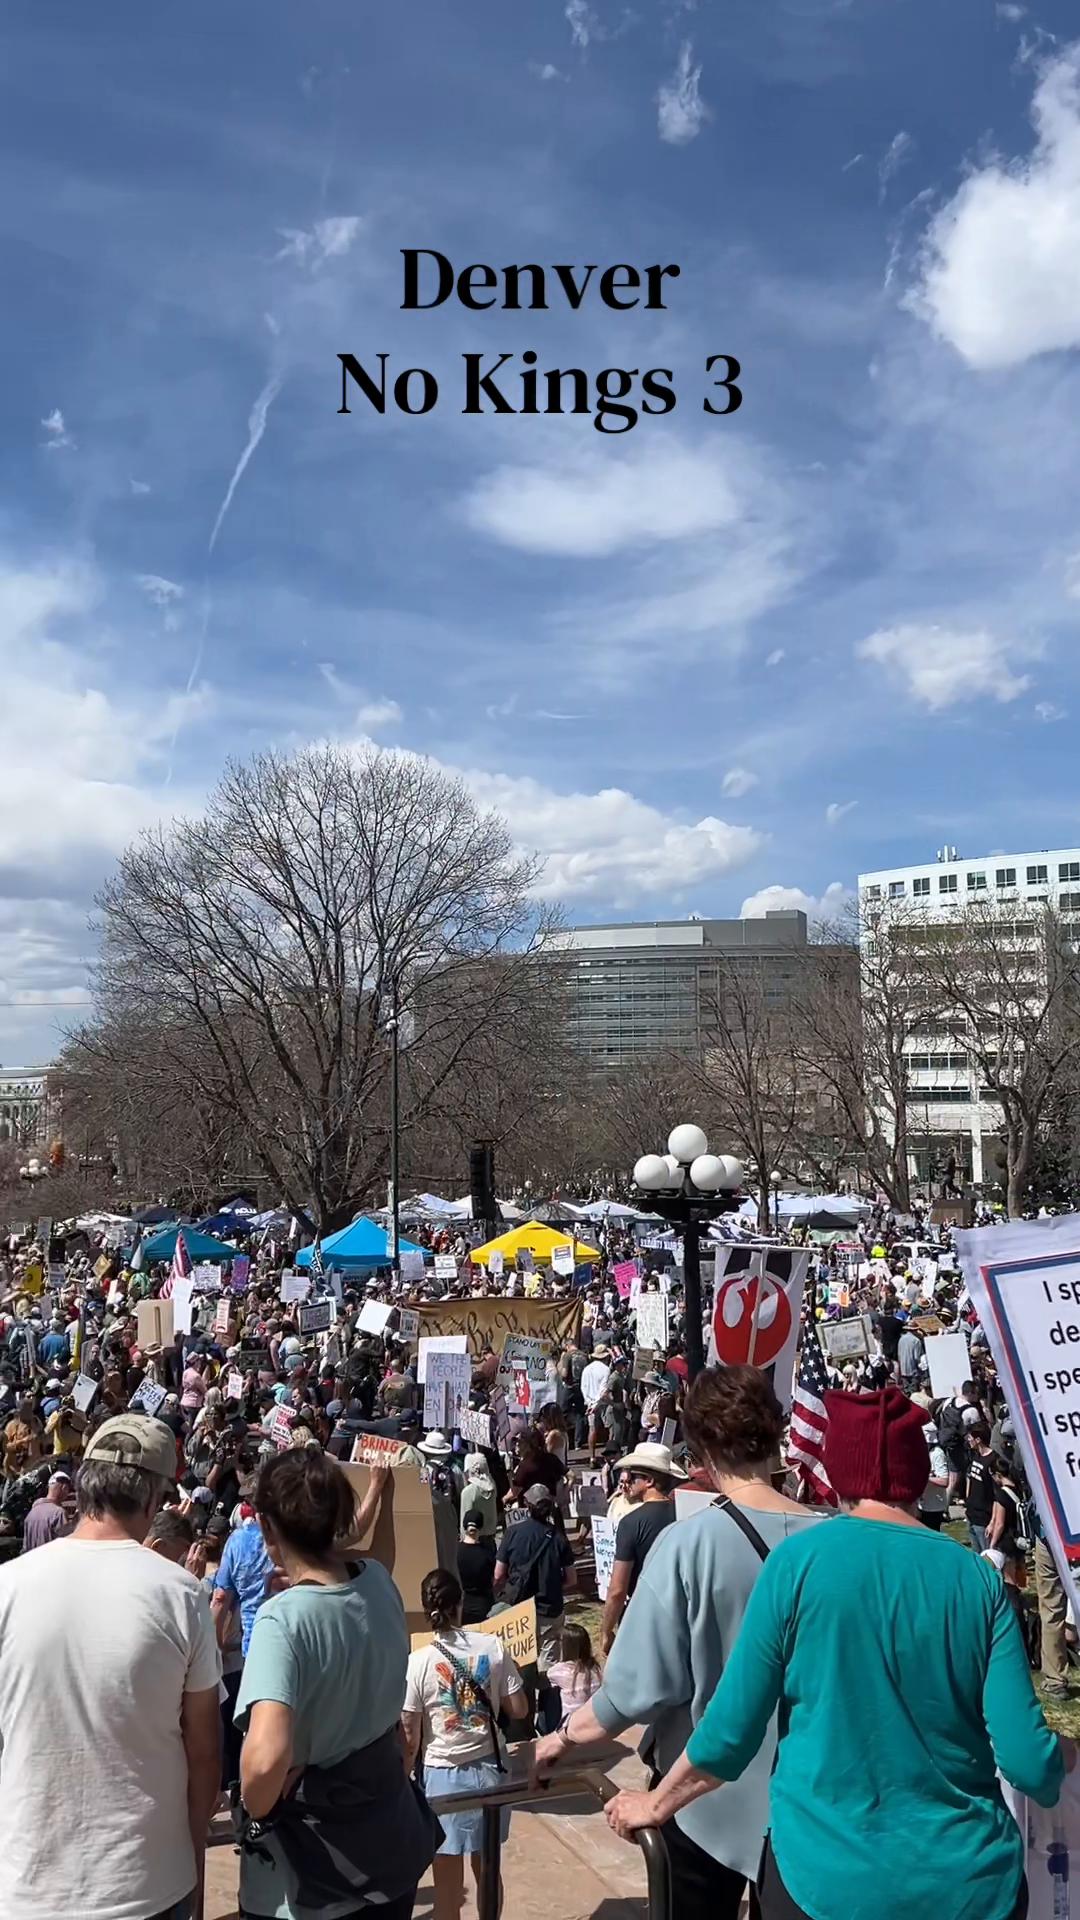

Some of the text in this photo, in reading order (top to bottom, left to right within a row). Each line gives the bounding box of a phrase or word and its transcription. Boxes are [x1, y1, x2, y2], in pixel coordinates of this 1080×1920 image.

[1043, 1281, 1053, 1303] I
[1050, 1320, 1080, 1345] de
[451, 1354, 467, 1366] THE
[432, 1365, 466, 1378] PEOPLE
[1029, 1370, 1039, 1393] I
[1039, 1412, 1049, 1436] I
[361, 1436, 399, 1452] BRING
[363, 1450, 379, 1460] ON
[593, 1519, 604, 1533] I
[490, 1616, 530, 1641] HEIR
